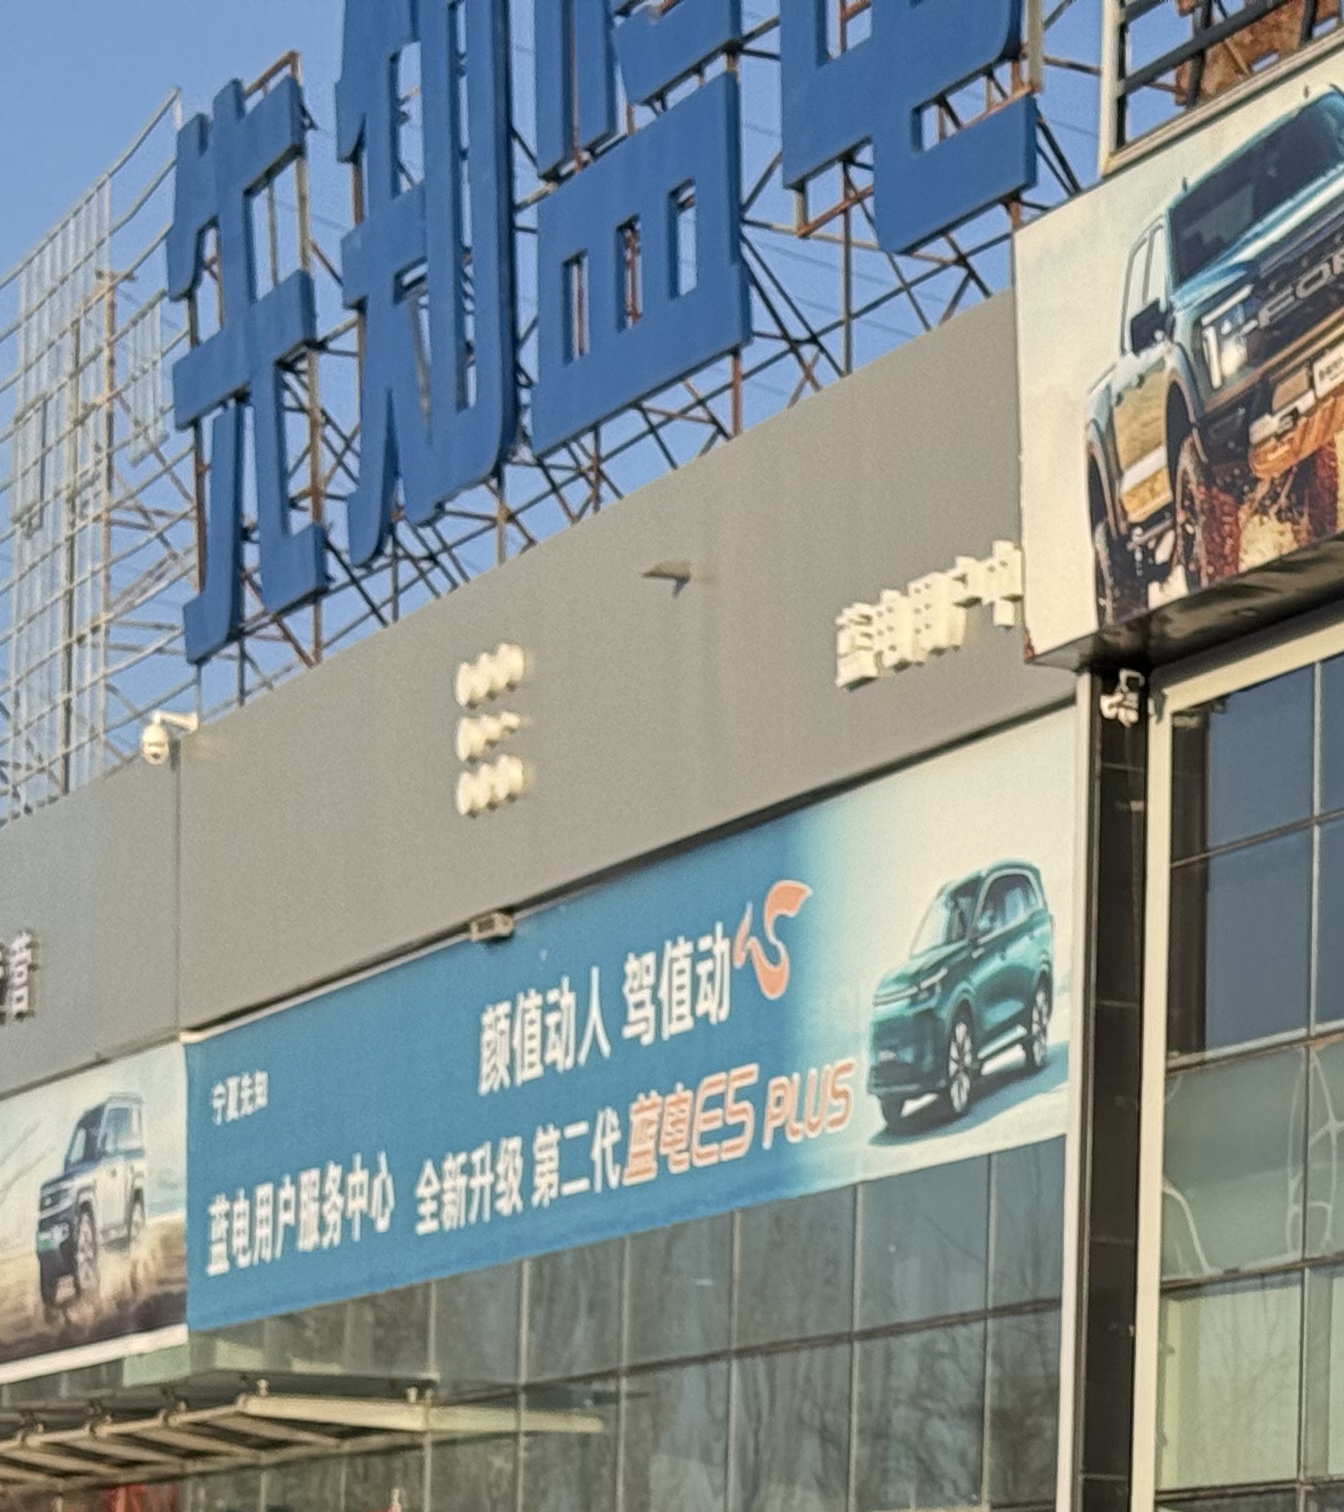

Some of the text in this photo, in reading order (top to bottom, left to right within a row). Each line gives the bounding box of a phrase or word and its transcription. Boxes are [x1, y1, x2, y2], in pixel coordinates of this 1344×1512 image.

[477, 966, 611, 1096] 颜值动人
[211, 1070, 268, 1125] 宁夏先知
[415, 1135, 523, 1235] 全新升级
[762, 1058, 856, 1150] PLUS
[206, 1151, 395, 1277] 蓝电用户服务中心
